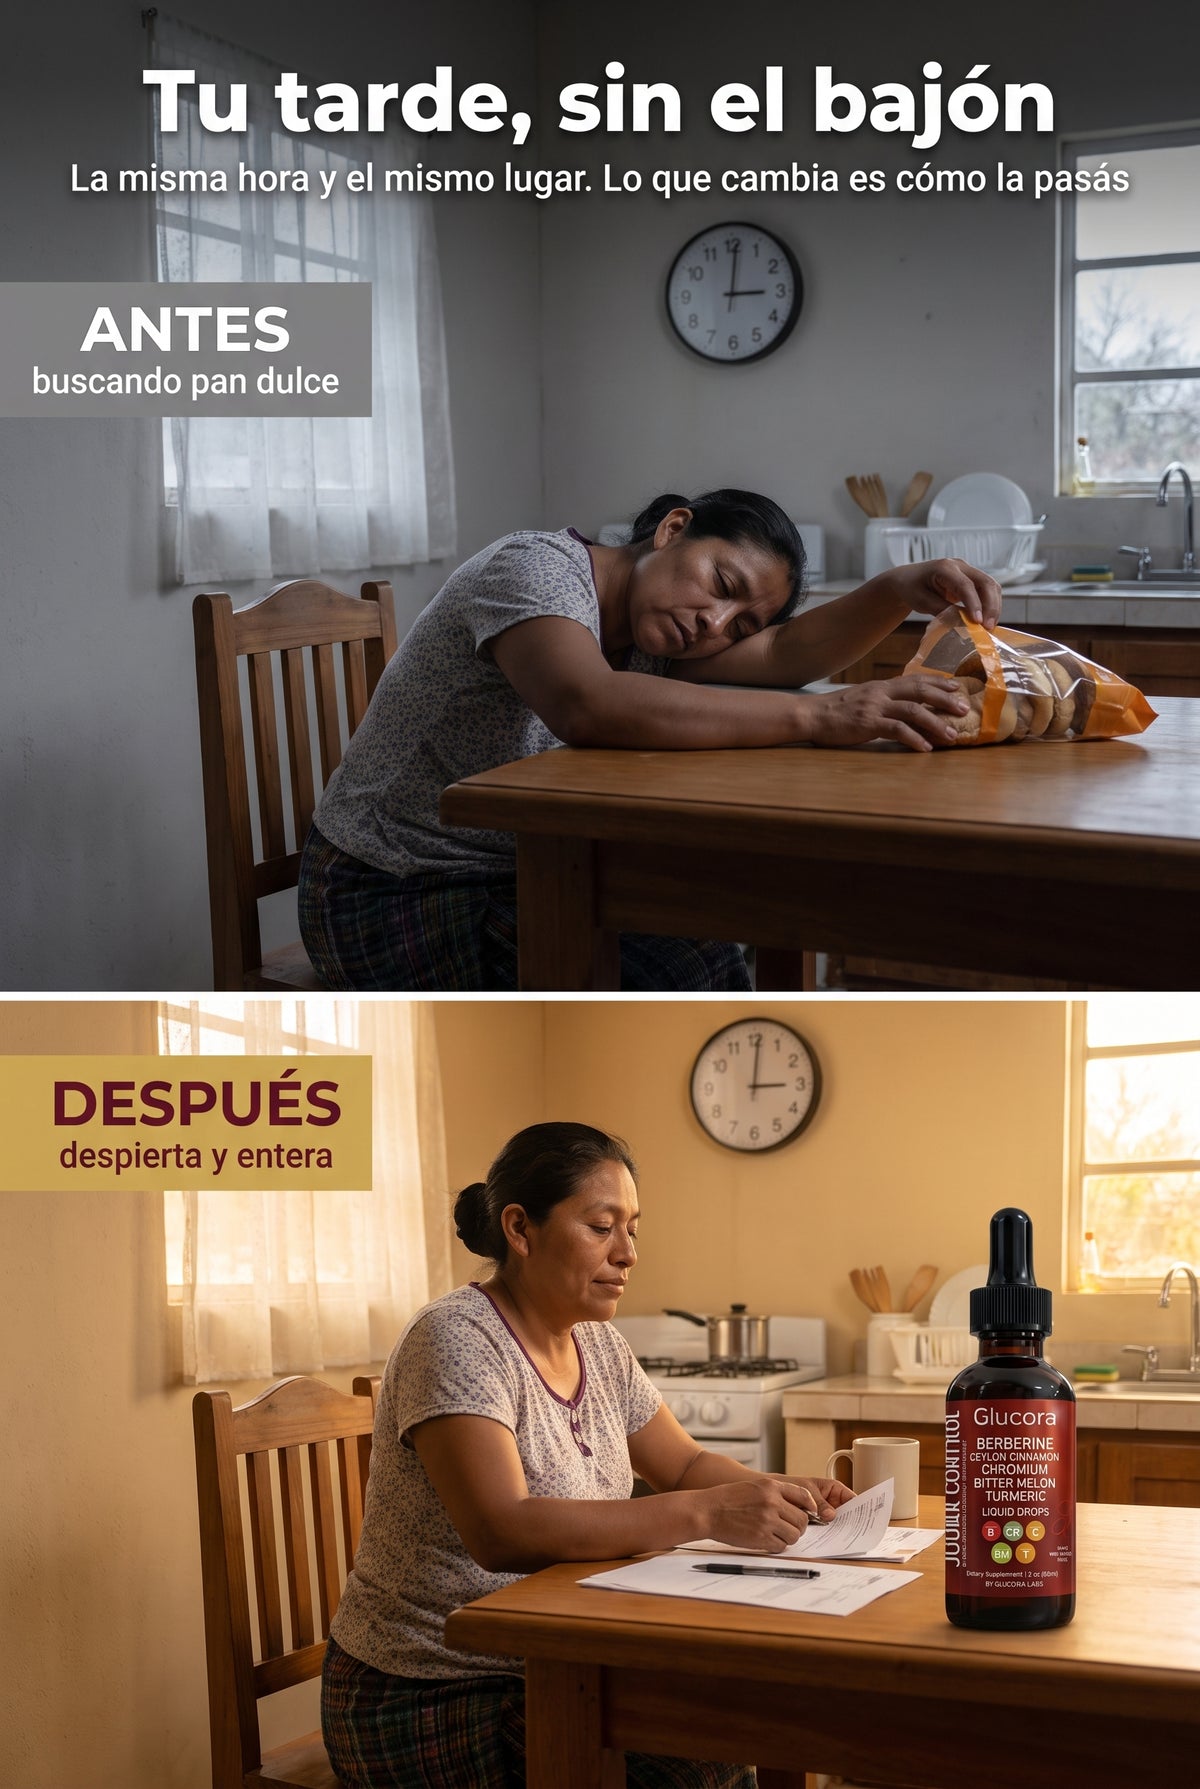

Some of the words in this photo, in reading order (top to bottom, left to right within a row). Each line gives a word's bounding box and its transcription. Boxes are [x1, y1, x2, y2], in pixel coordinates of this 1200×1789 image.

[724, 238, 741, 253] 12
[753, 243, 759, 258] 1
[704, 247, 717, 261] 11
[688, 266, 704, 281] 10
[768, 259, 779, 274] 2
[681, 290, 691, 305] 9
[775, 283, 786, 298] 3
[688, 313, 698, 329] 8
[768, 309, 778, 323] 4
[706, 330, 716, 344] 7
[752, 327, 761, 342] 5
[728, 335, 738, 350] 6
[748, 1033, 763, 1047] 12
[774, 1039, 780, 1052] 1
[728, 1042, 740, 1055] 11
[713, 1059, 727, 1073] 10
[788, 1054, 798, 1068] 2
[704, 1082, 714, 1096] 9
[795, 1077, 806, 1091] 3
[712, 1104, 721, 1118] 8
[788, 1101, 798, 1114] 4
[729, 1121, 738, 1134] 7
[772, 1118, 782, 1132] 5
[750, 1126, 760, 1140] 6
[974, 1407, 1057, 1426] Glucora
[976, 1437, 1054, 1450] BERBERINE
[969, 1452, 1006, 1461] CEYLON
[1009, 1452, 1060, 1461] CINNAMON
[981, 1463, 1048, 1475] CHROMIUM
[974, 1477, 1013, 1488] BITTER
[1017, 1477, 1056, 1488] MELON
[985, 1490, 1046, 1501] TURMERIC
[982, 1507, 1015, 1517] LIQUID
[1017, 1507, 1050, 1517] DROPS
[987, 1528, 994, 1536] B
[1005, 1528, 1020, 1536] CR
[1032, 1528, 1039, 1536] C
[994, 1550, 1010, 1559] BM
[1022, 1550, 1030, 1559] T
